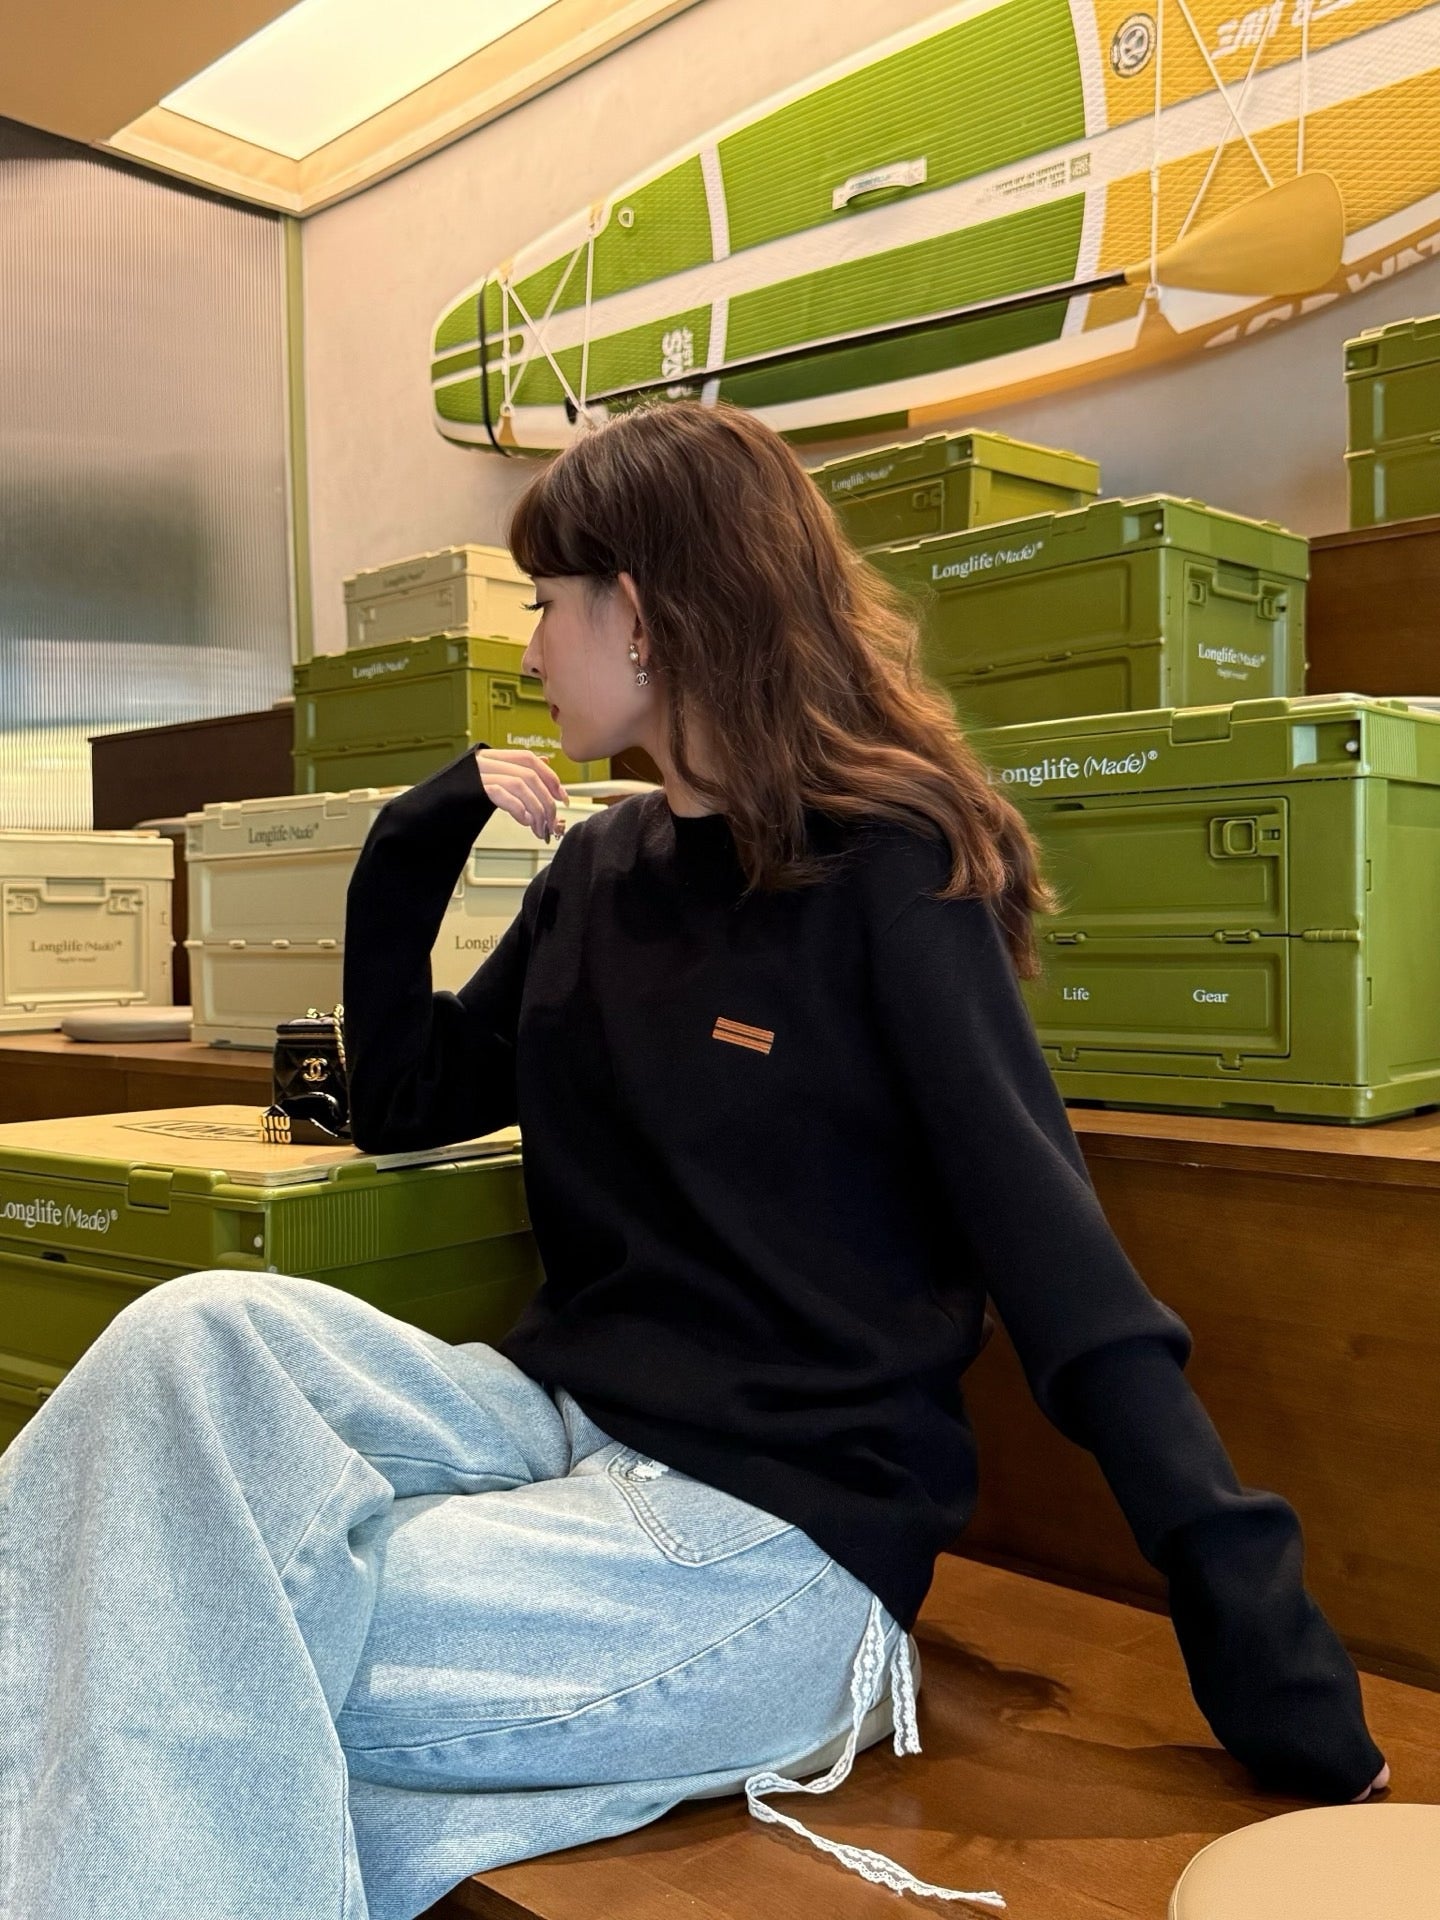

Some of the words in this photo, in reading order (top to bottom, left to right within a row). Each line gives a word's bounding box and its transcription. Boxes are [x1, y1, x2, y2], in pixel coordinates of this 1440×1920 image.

[932, 552, 993, 580] Longlife
[1198, 642, 1237, 666] Longlife
[31, 939, 83, 955] Longlife
[1063, 987, 1090, 1001] Life
[1192, 989, 1229, 1004] Gear
